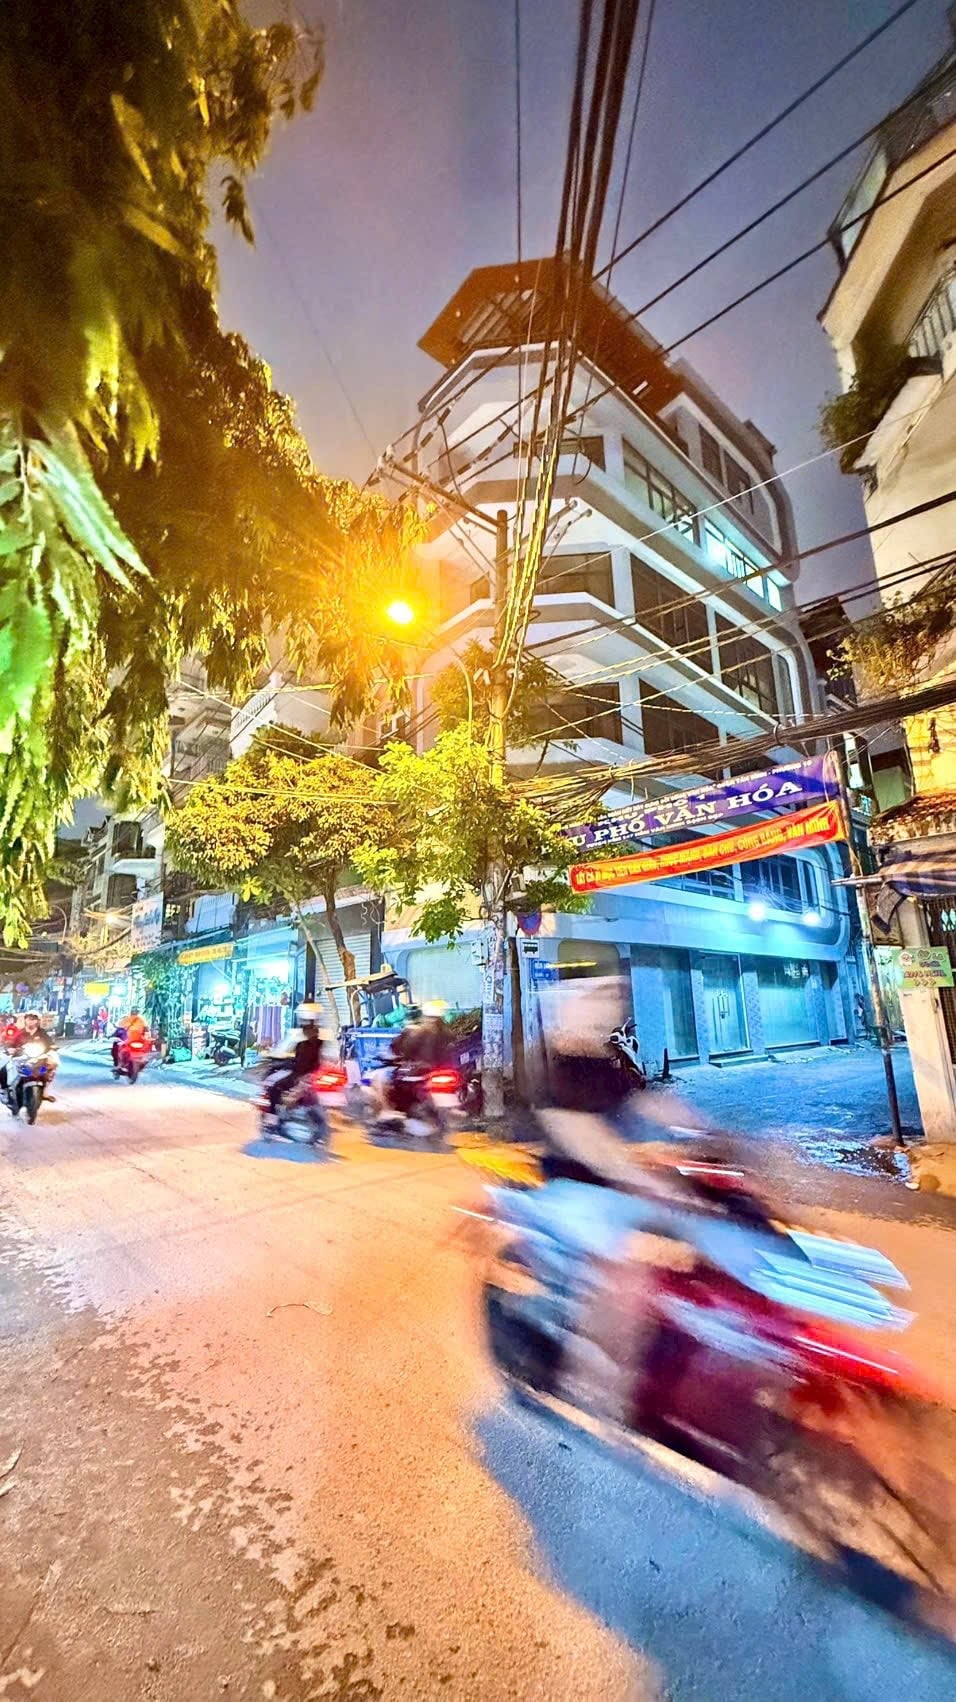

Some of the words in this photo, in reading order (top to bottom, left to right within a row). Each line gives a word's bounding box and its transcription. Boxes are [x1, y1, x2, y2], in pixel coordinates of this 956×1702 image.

[594, 814, 645, 841] PHỐ
[654, 801, 717, 825] VĂN
[727, 781, 803, 810] HÓA
